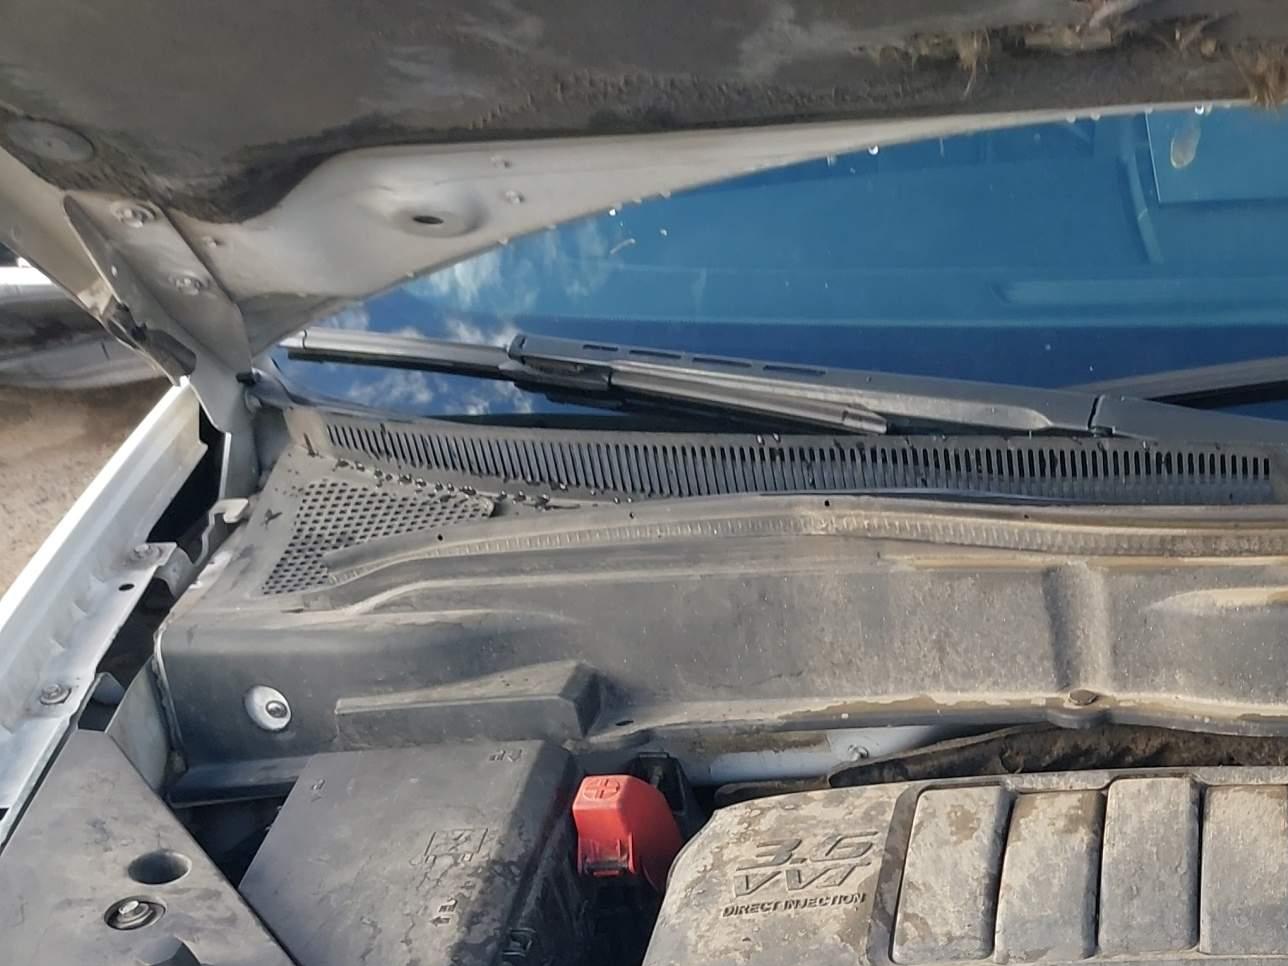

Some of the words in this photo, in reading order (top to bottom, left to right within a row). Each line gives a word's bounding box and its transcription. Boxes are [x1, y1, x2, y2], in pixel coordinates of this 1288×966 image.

[736, 831, 878, 870] 3.6
[733, 861, 870, 897] VVT
[723, 900, 782, 917] DIRECT
[783, 893, 866, 911] INJECTION
